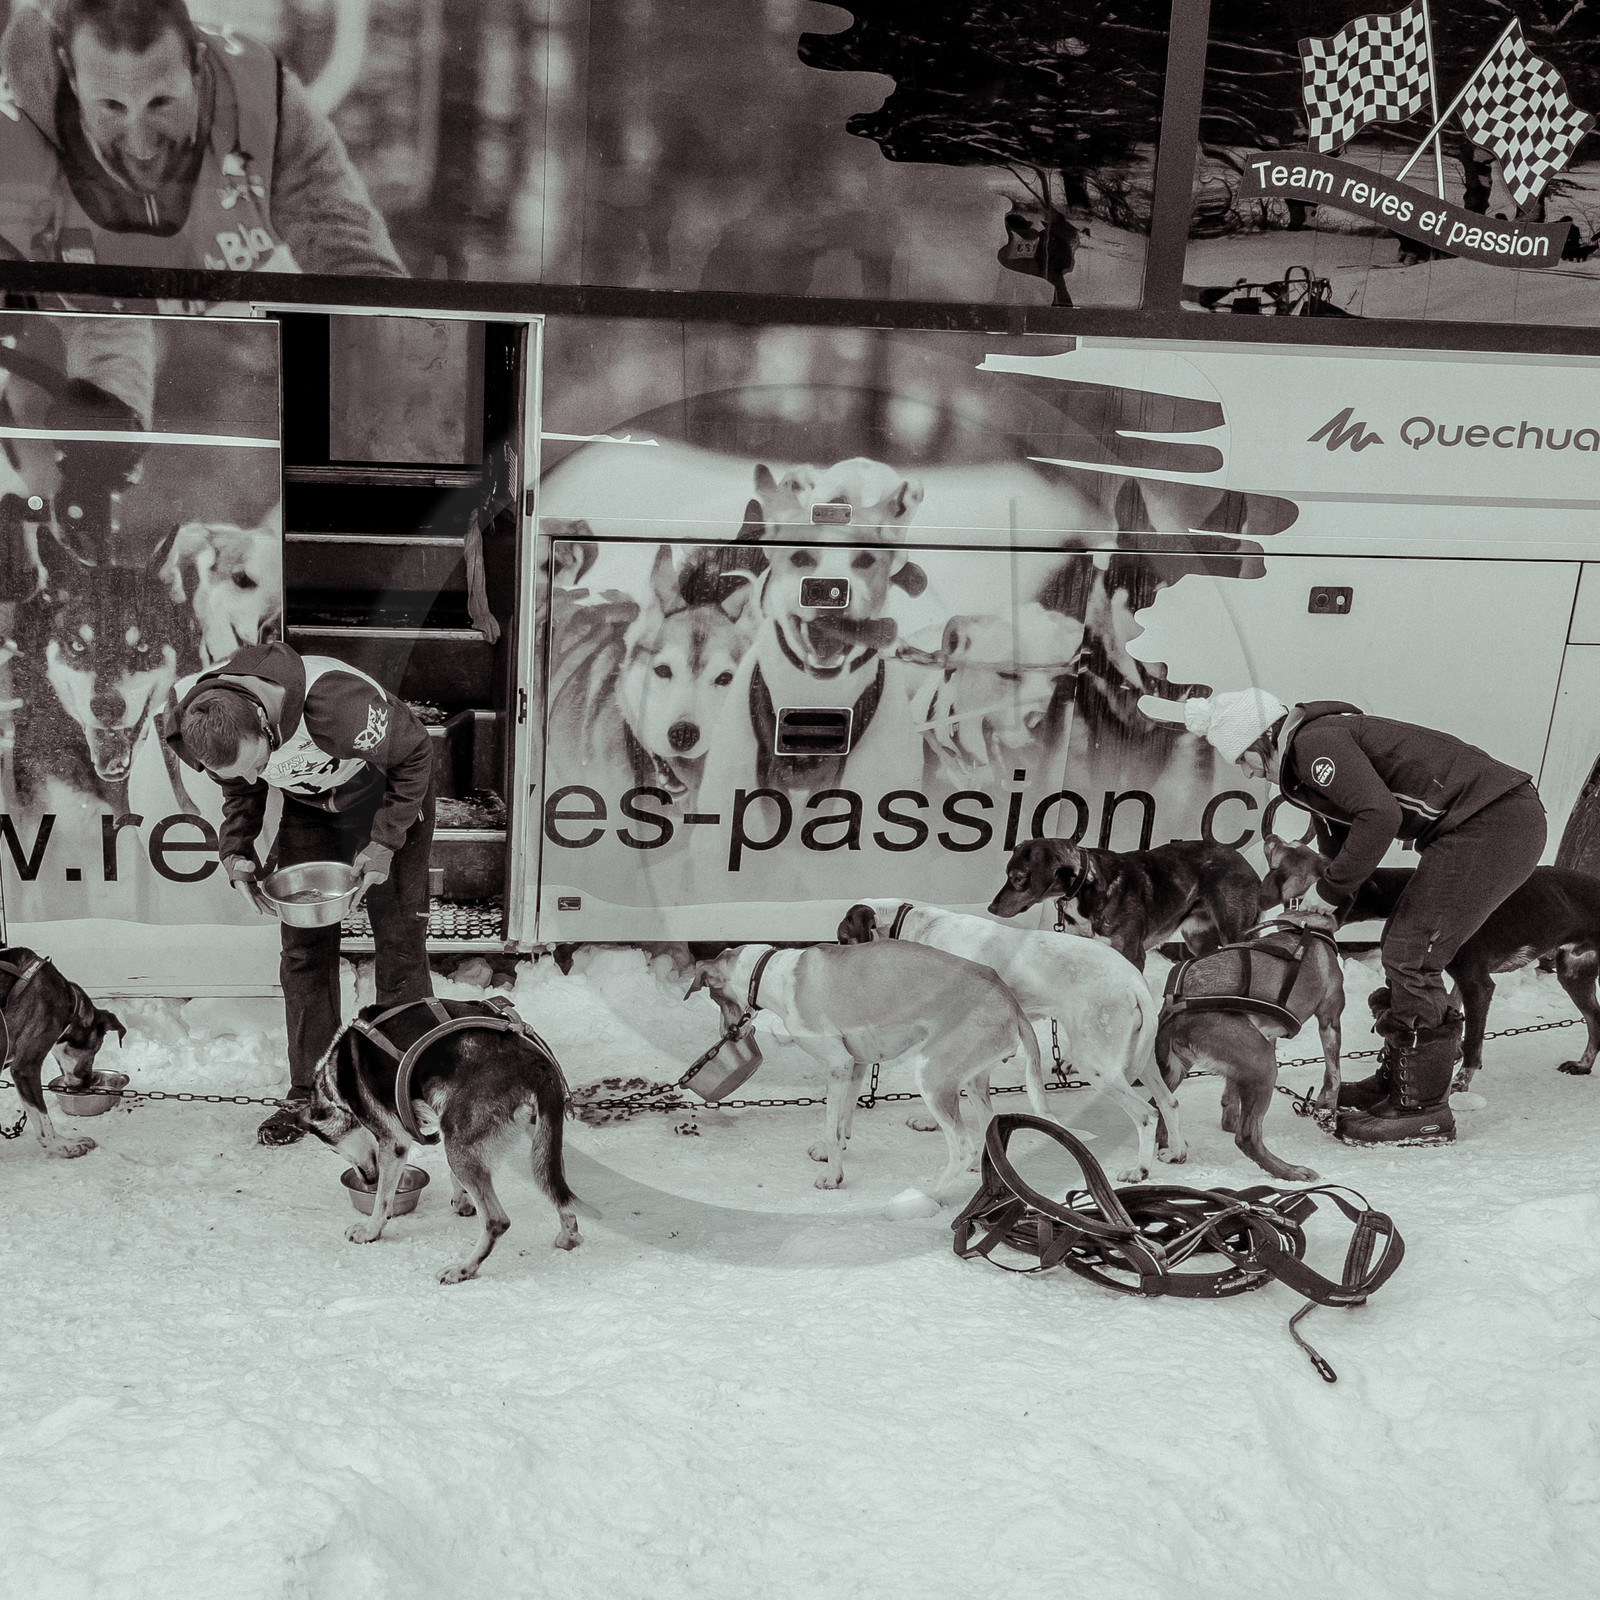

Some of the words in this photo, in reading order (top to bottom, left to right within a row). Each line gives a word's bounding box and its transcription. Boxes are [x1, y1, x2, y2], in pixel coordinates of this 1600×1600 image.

[1251, 161, 1335, 194] Team
[1340, 177, 1415, 223] reves
[1418, 210, 1448, 236] et
[1445, 229, 1549, 257] passion
[1400, 416, 1600, 452] Quechua
